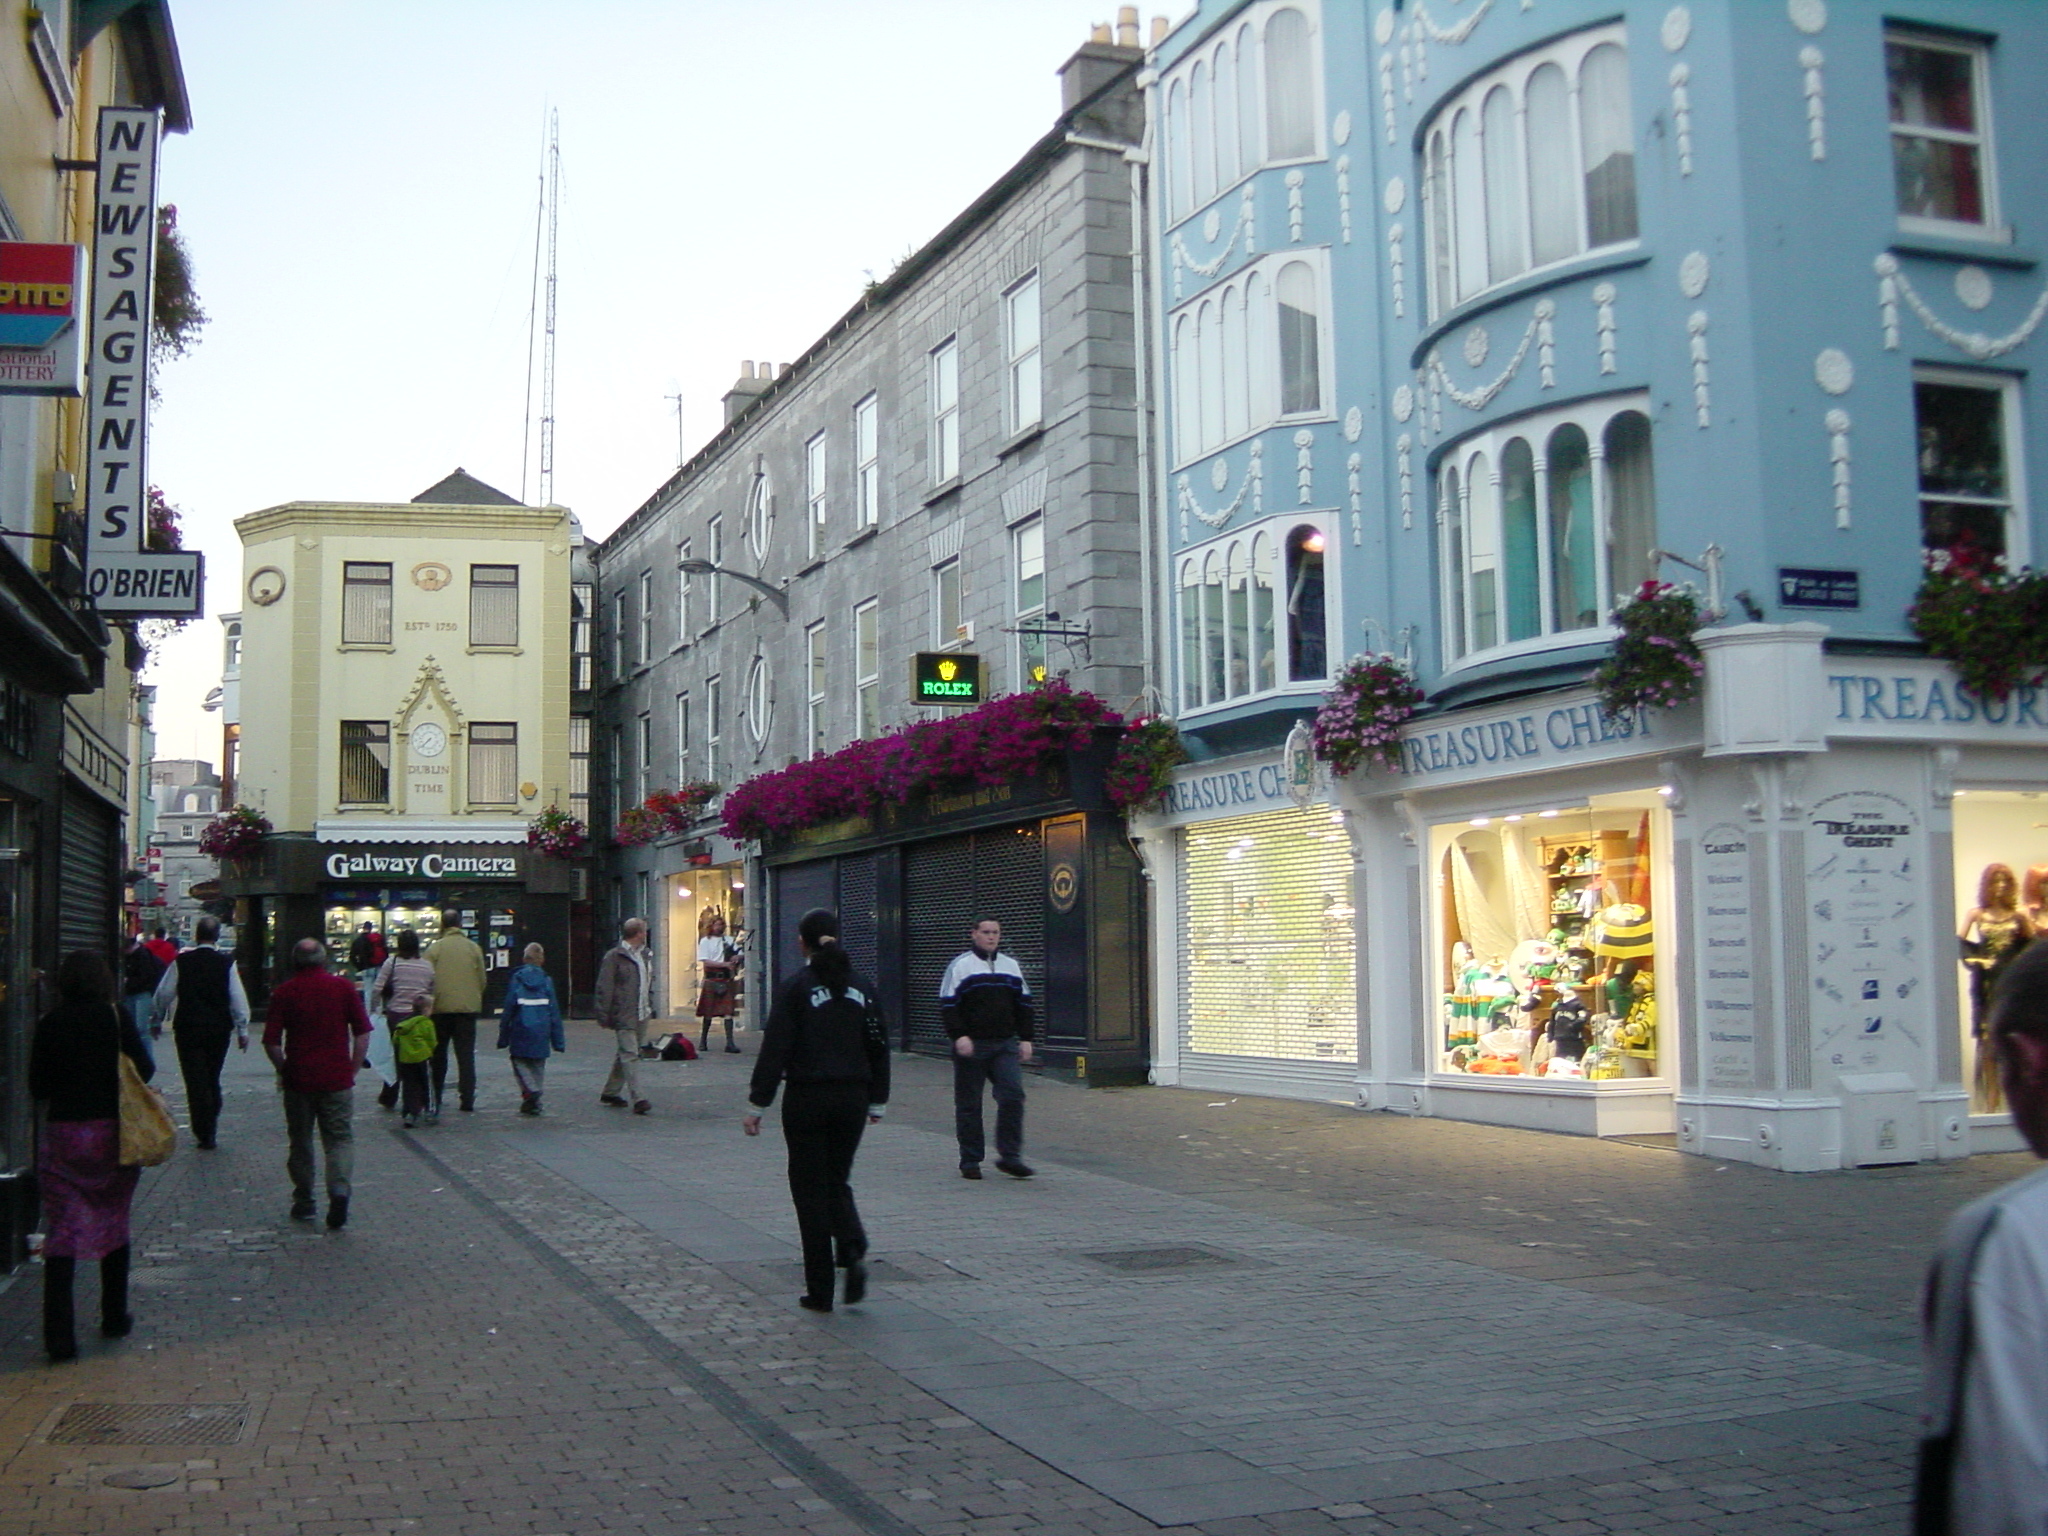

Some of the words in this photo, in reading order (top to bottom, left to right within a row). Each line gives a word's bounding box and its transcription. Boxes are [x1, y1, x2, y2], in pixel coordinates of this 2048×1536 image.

[99, 120, 147, 539] NEWSAGENTS
[89, 568, 194, 598] O'BRIEN
[922, 682, 973, 696] ROLEX
[1828, 675, 2048, 726] TREASUR
[408, 765, 450, 775] DUBLIN
[414, 784, 444, 793] TIME
[1812, 820, 1911, 836] TREASURE
[1843, 836, 1896, 848] CHEST
[326, 853, 420, 878] Galway
[421, 853, 517, 878] Camera
